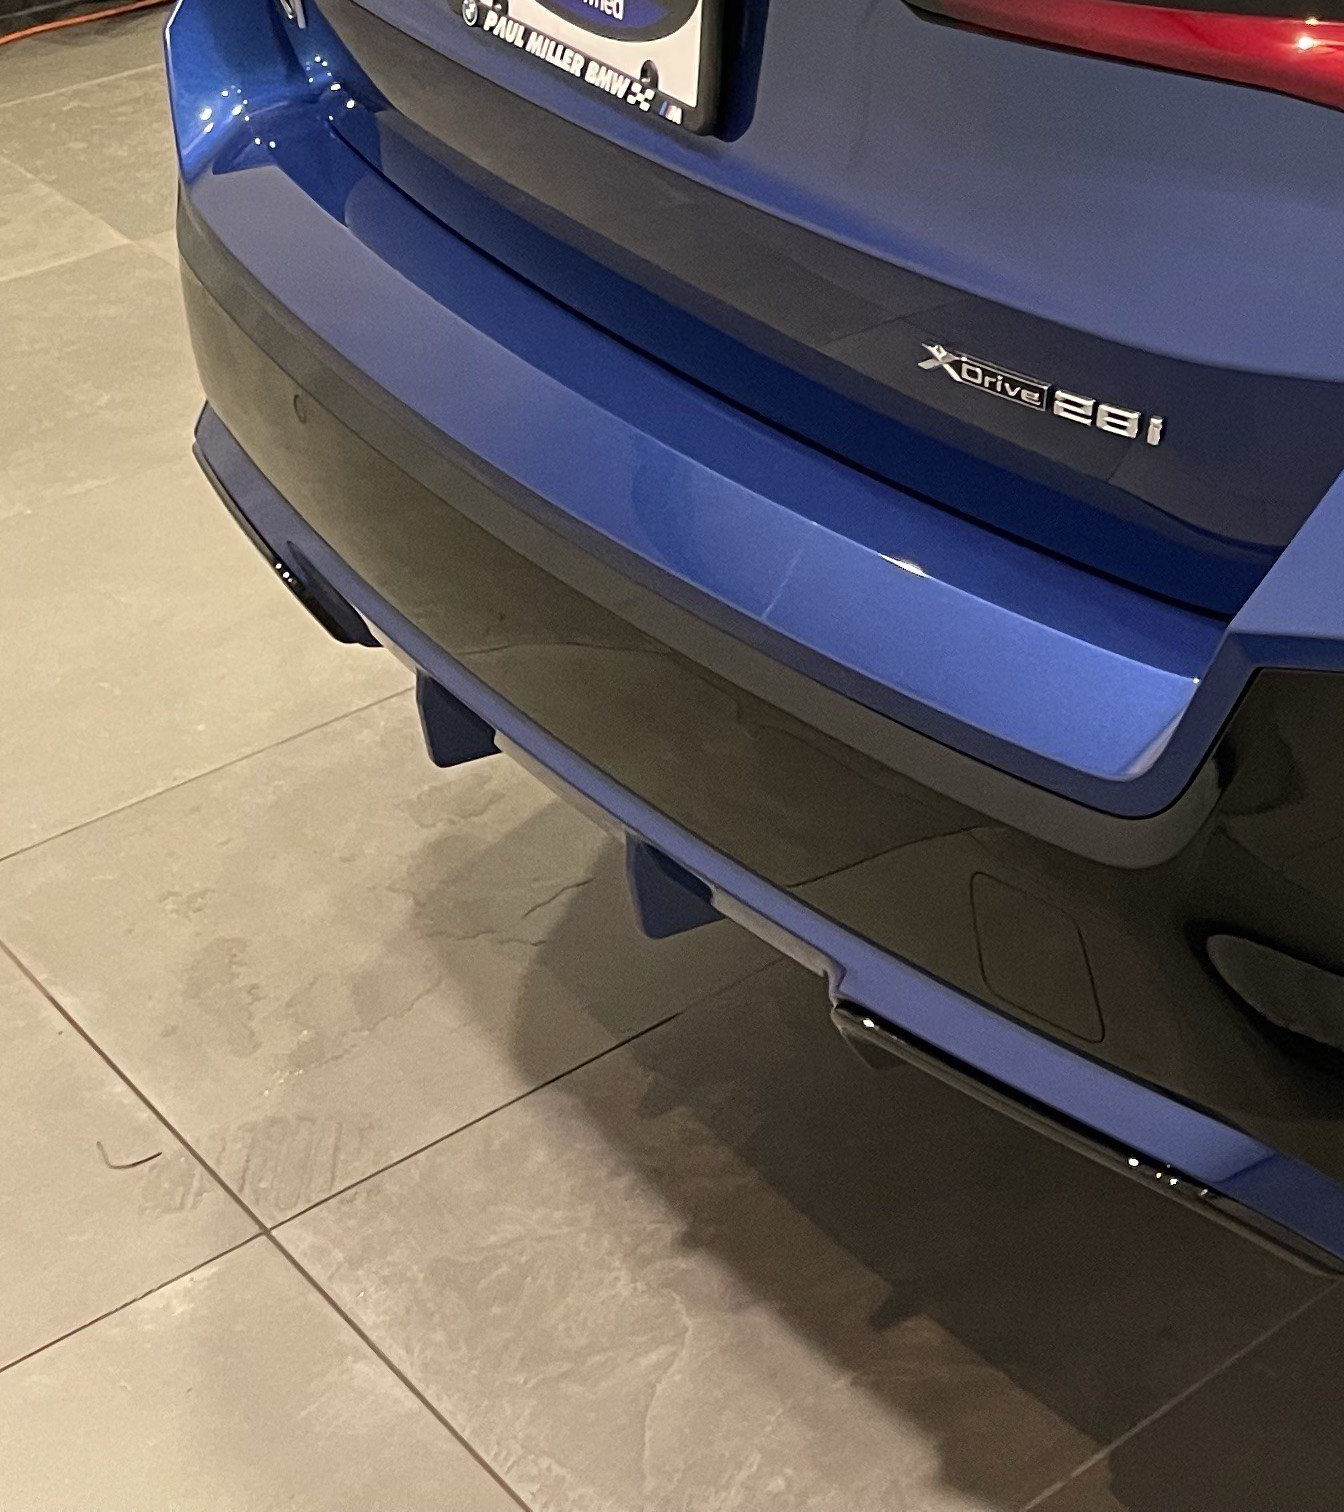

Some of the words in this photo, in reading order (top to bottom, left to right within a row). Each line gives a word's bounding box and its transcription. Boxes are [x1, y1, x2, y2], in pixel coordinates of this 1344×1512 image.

[483, 9, 526, 49] PAUL
[525, 31, 586, 77] MILLER
[585, 60, 632, 99] BMW
